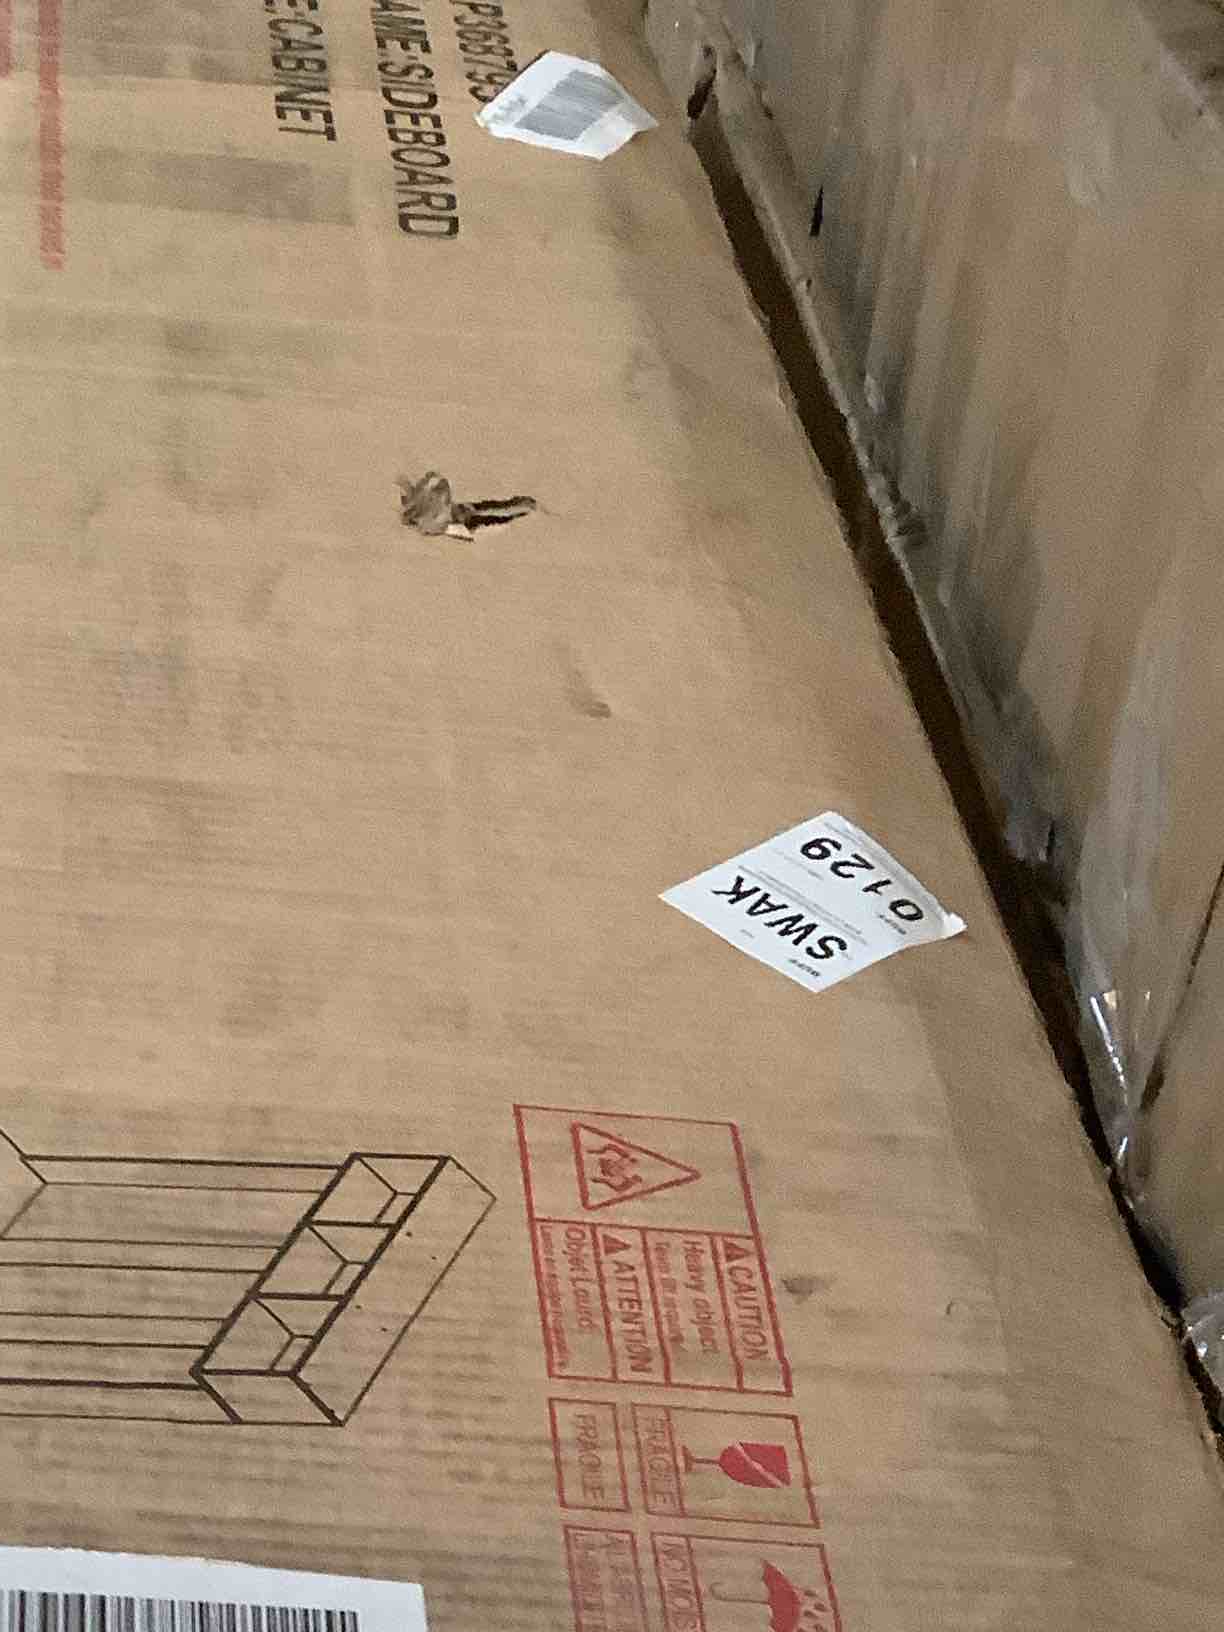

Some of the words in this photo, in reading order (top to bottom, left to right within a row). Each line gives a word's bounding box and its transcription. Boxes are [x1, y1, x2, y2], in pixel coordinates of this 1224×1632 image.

[711, 875, 849, 960] SWAK
[799, 836, 925, 923] 0129
[682, 1239, 707, 1292] Heavy
[613, 1259, 653, 1374] ATTENTION
[727, 1264, 769, 1361] CAUTION
